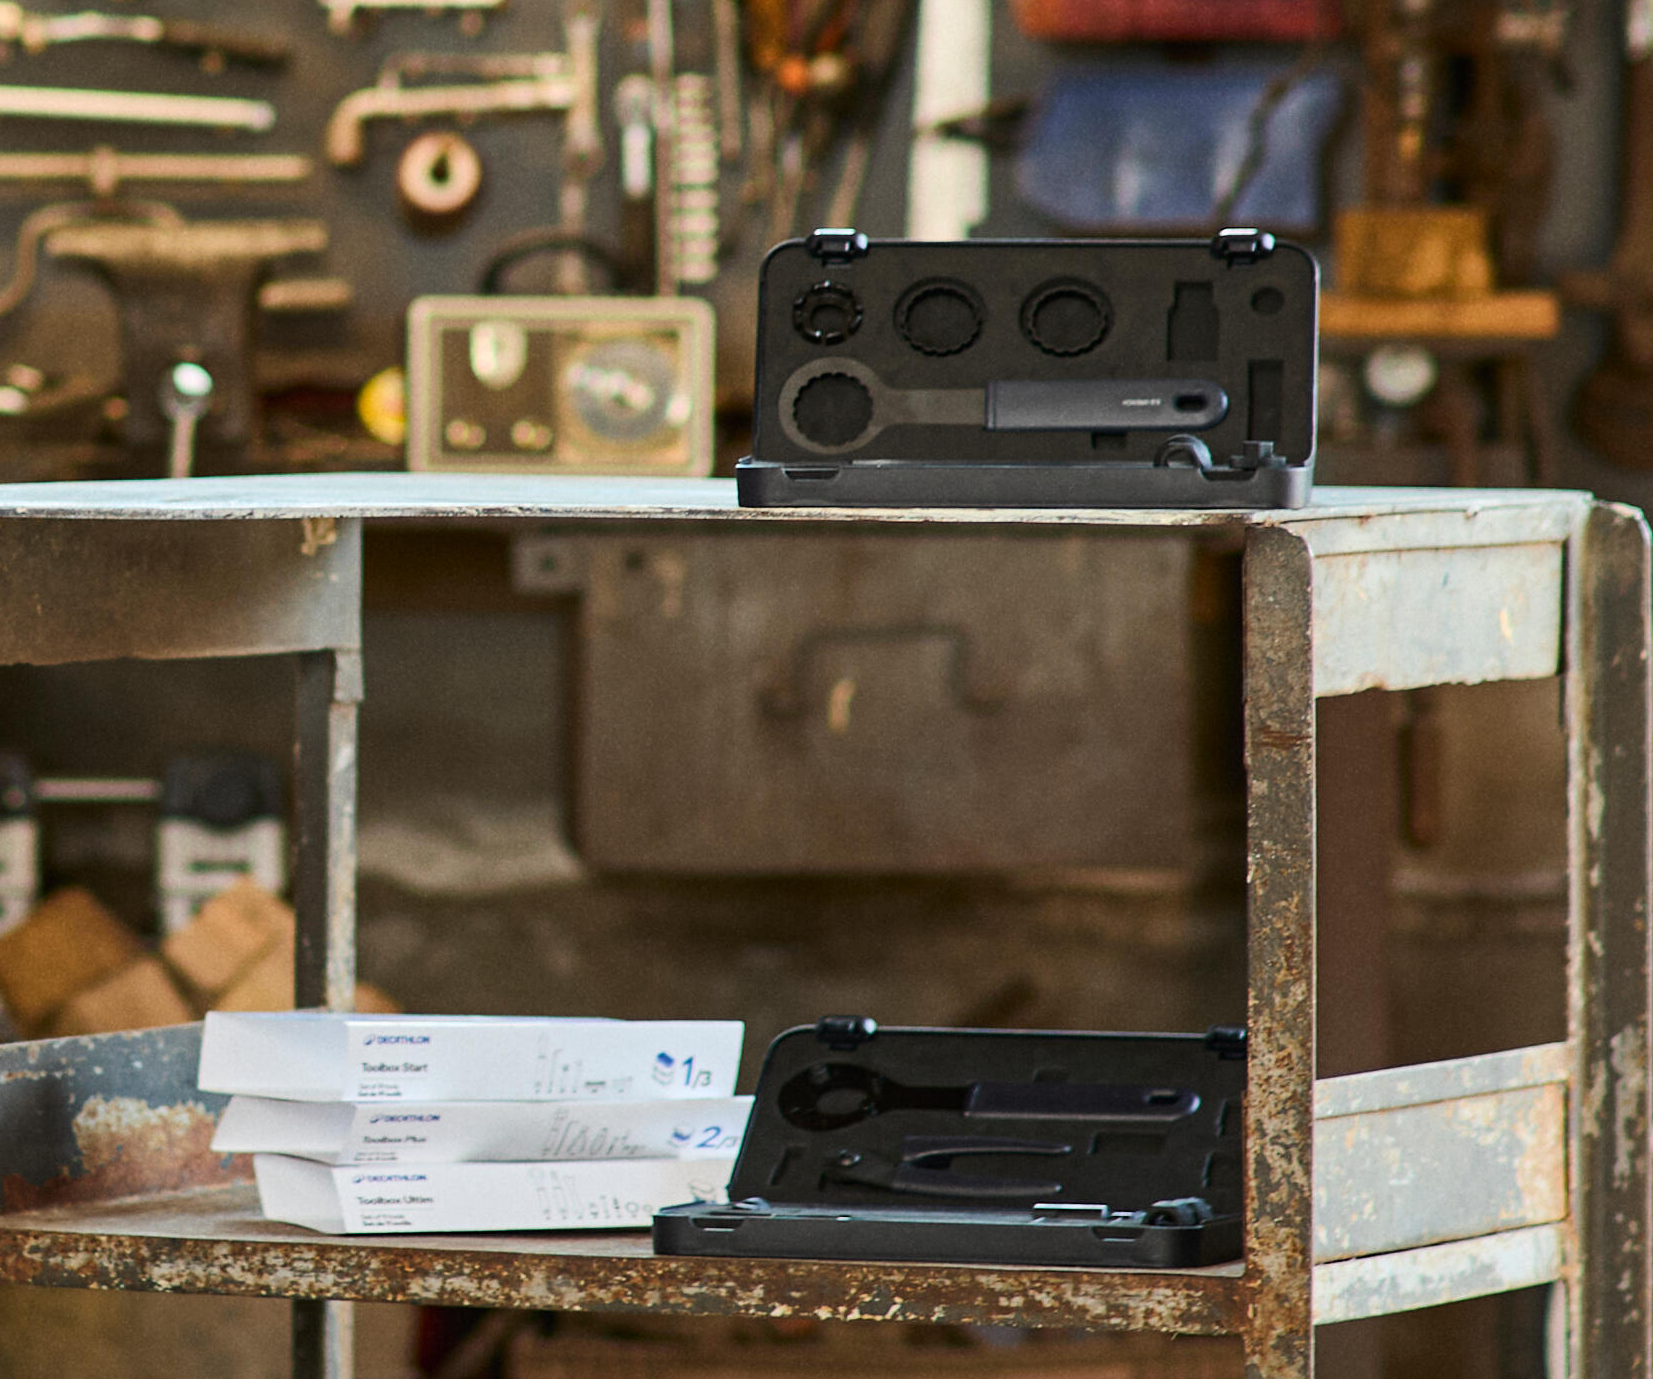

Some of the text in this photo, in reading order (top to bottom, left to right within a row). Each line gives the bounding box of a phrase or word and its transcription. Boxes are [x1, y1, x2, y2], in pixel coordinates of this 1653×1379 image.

[361, 1062, 429, 1073] Toolbox Start
[682, 1055, 712, 1090] 1/3
